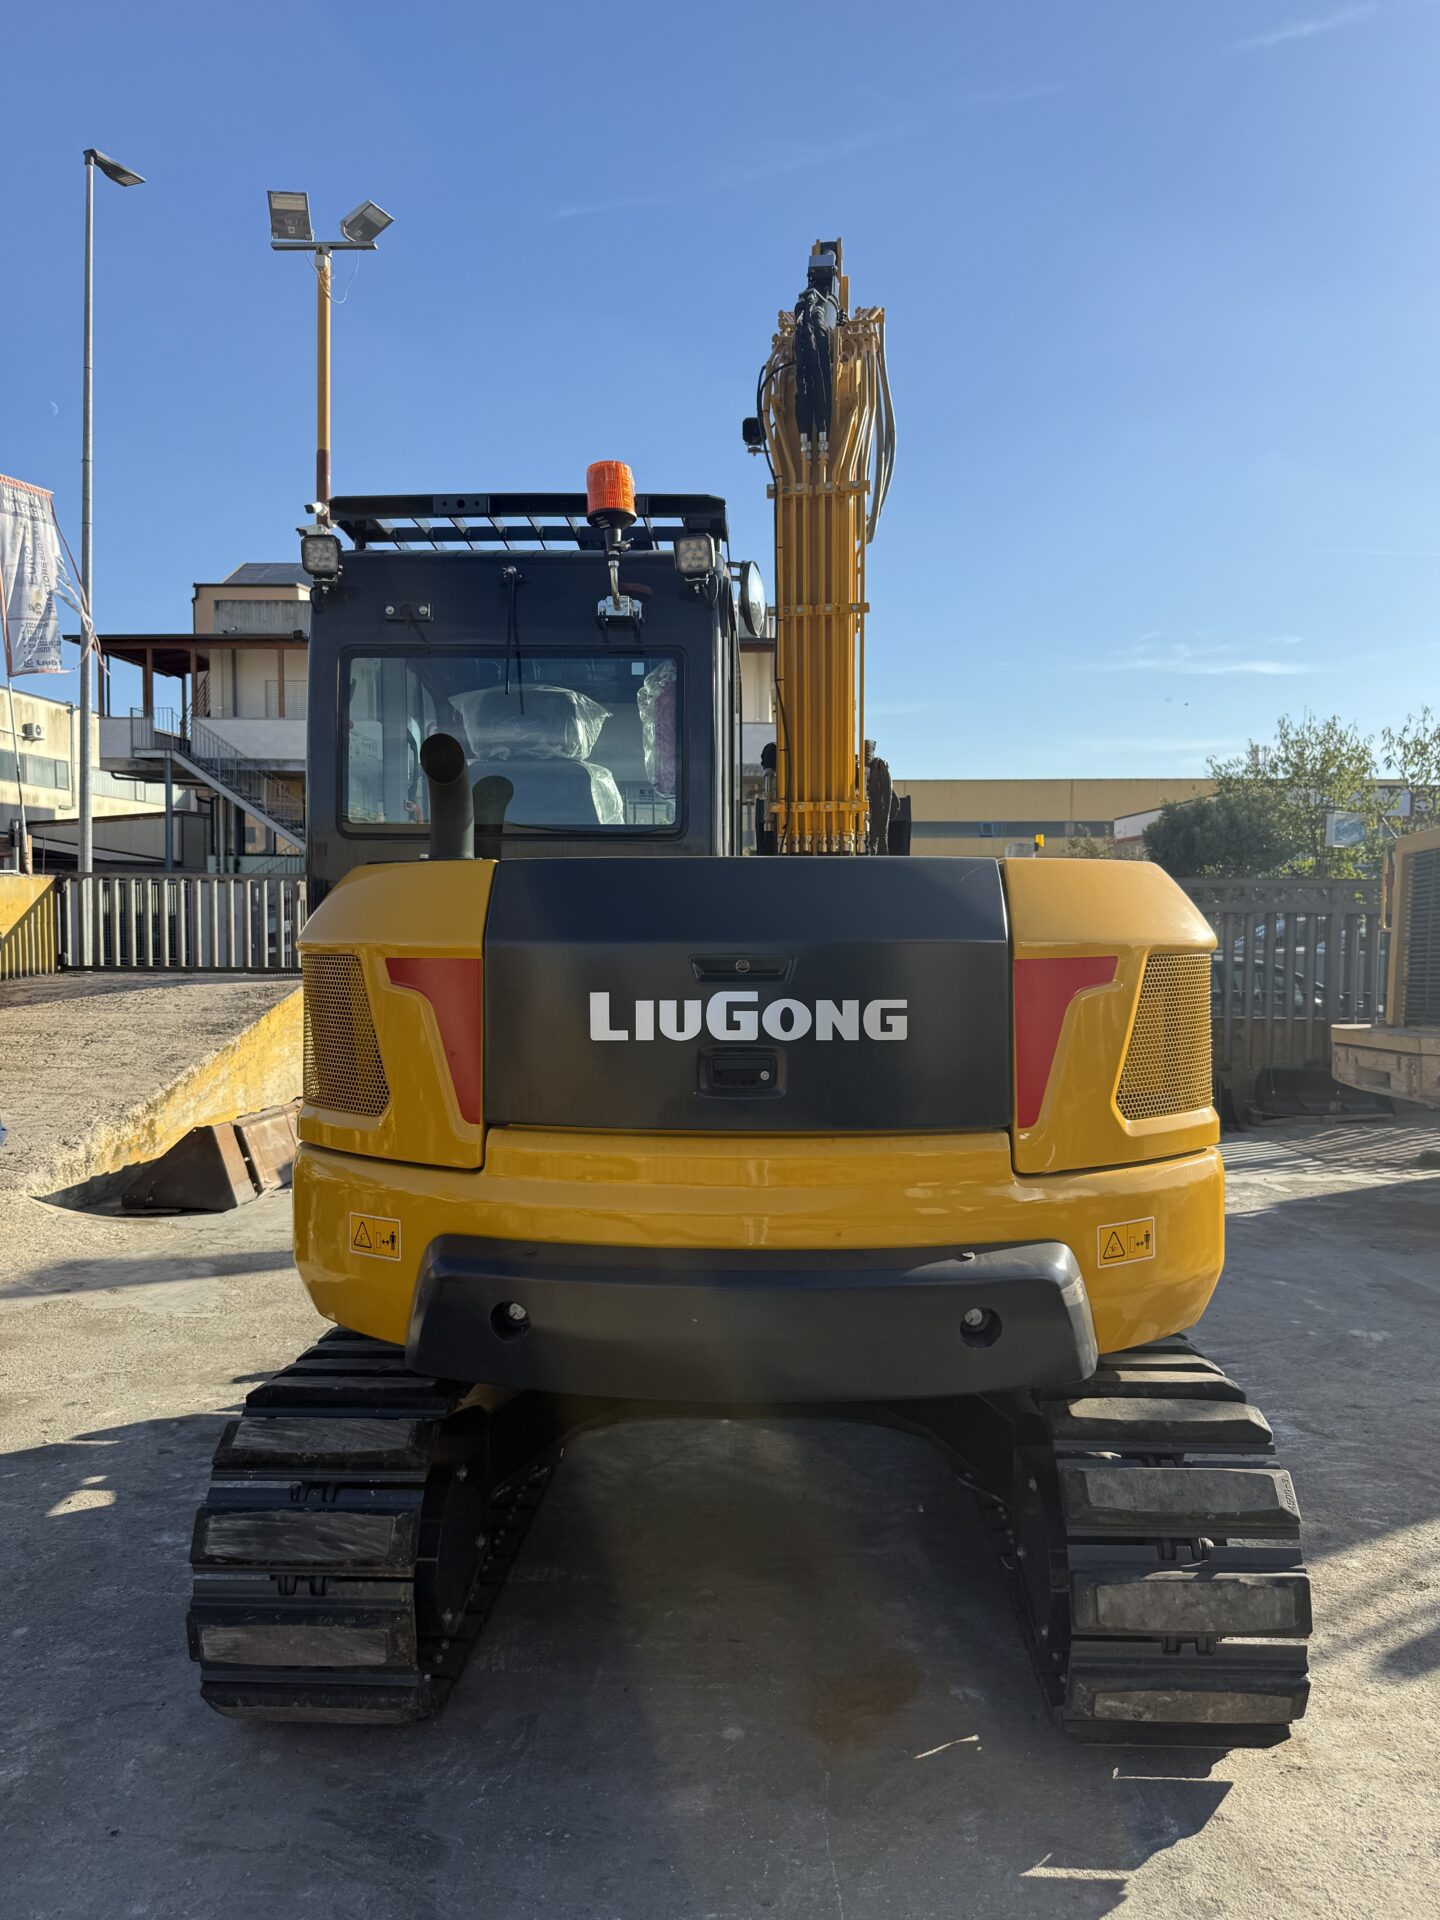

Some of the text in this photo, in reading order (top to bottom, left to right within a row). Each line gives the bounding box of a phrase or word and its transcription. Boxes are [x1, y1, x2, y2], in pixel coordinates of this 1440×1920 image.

[3, 486, 41, 507] VENDITA
[25, 546, 38, 586] EURO
[40, 563, 56, 613] TRACTORS
